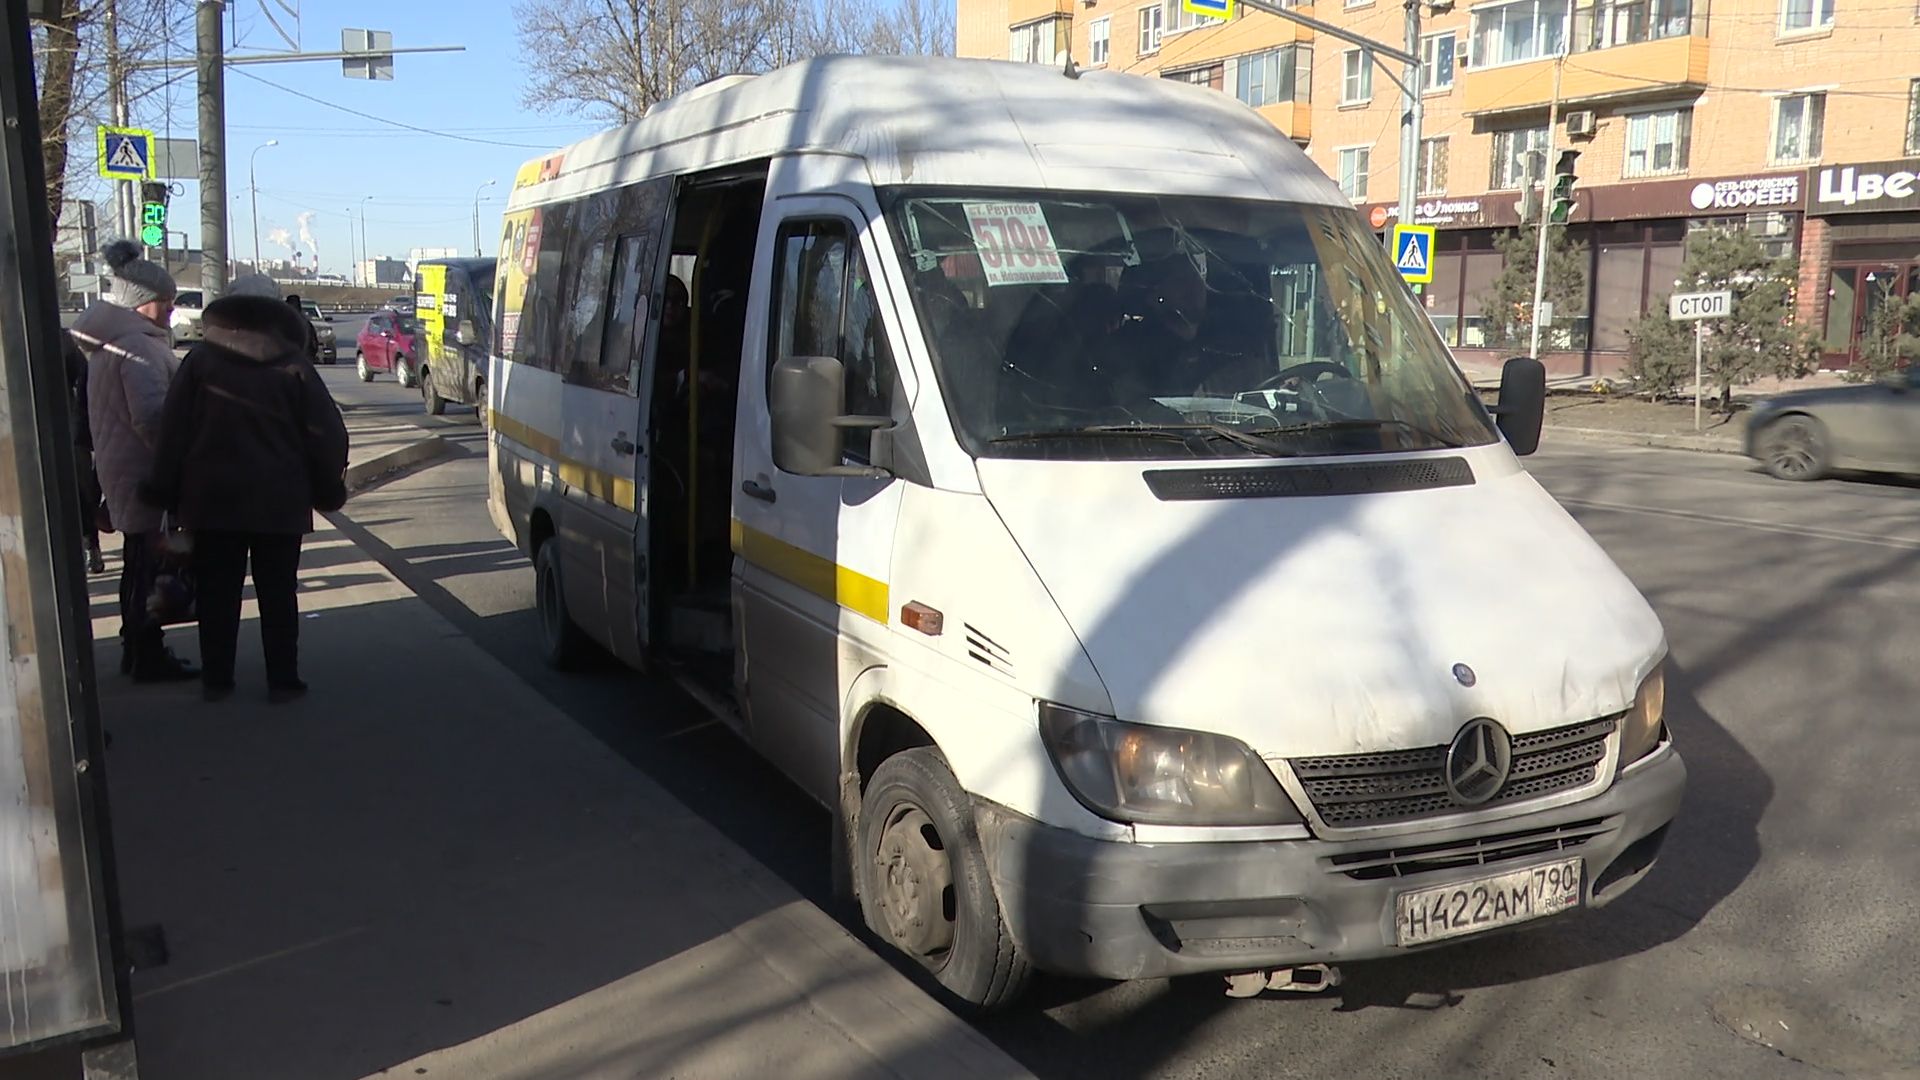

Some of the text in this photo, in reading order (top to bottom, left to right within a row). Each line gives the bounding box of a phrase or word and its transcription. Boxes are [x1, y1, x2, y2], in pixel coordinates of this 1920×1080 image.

[1715, 176, 1799, 192] СЕТЬ ГОРОДСКИХ
[1818, 167, 1920, 206] Цве
[1714, 187, 1799, 208] КОФЕЕН
[144, 204, 165, 224] 20
[986, 204, 1037, 216] Реутово
[1680, 296, 1723, 314] СТОП
[1410, 865, 1573, 937] Н422АМ 790
[1545, 896, 1564, 908] RUS
